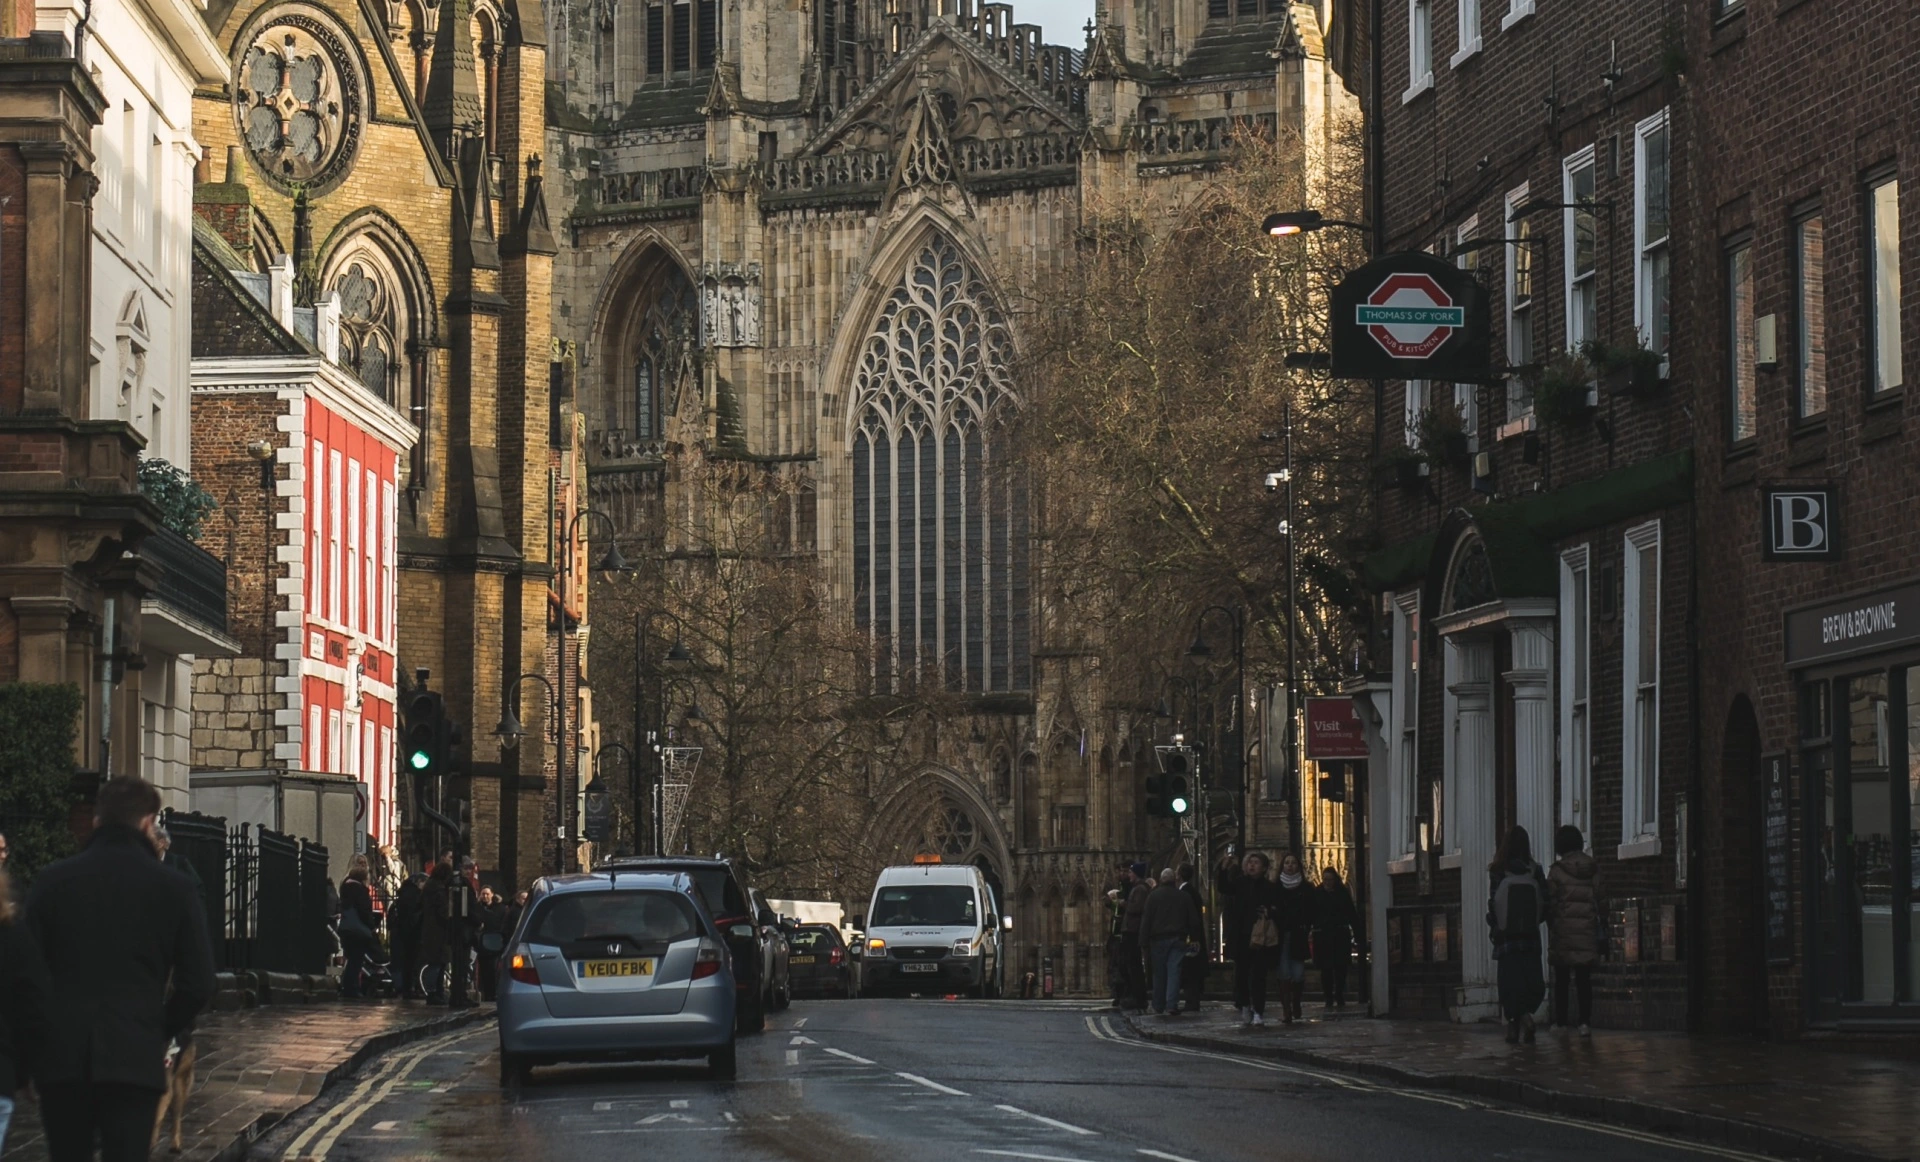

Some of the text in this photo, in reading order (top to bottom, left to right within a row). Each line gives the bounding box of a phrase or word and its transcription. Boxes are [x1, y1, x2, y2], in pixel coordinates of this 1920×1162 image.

[1365, 310, 1455, 321] THOMAS'S OF YORK
[1382, 333, 1439, 353] PUB & KITCHEN
[1775, 495, 1825, 550] B
[1313, 720, 1341, 731] Visit
[588, 961, 648, 976] YE10 FBK
